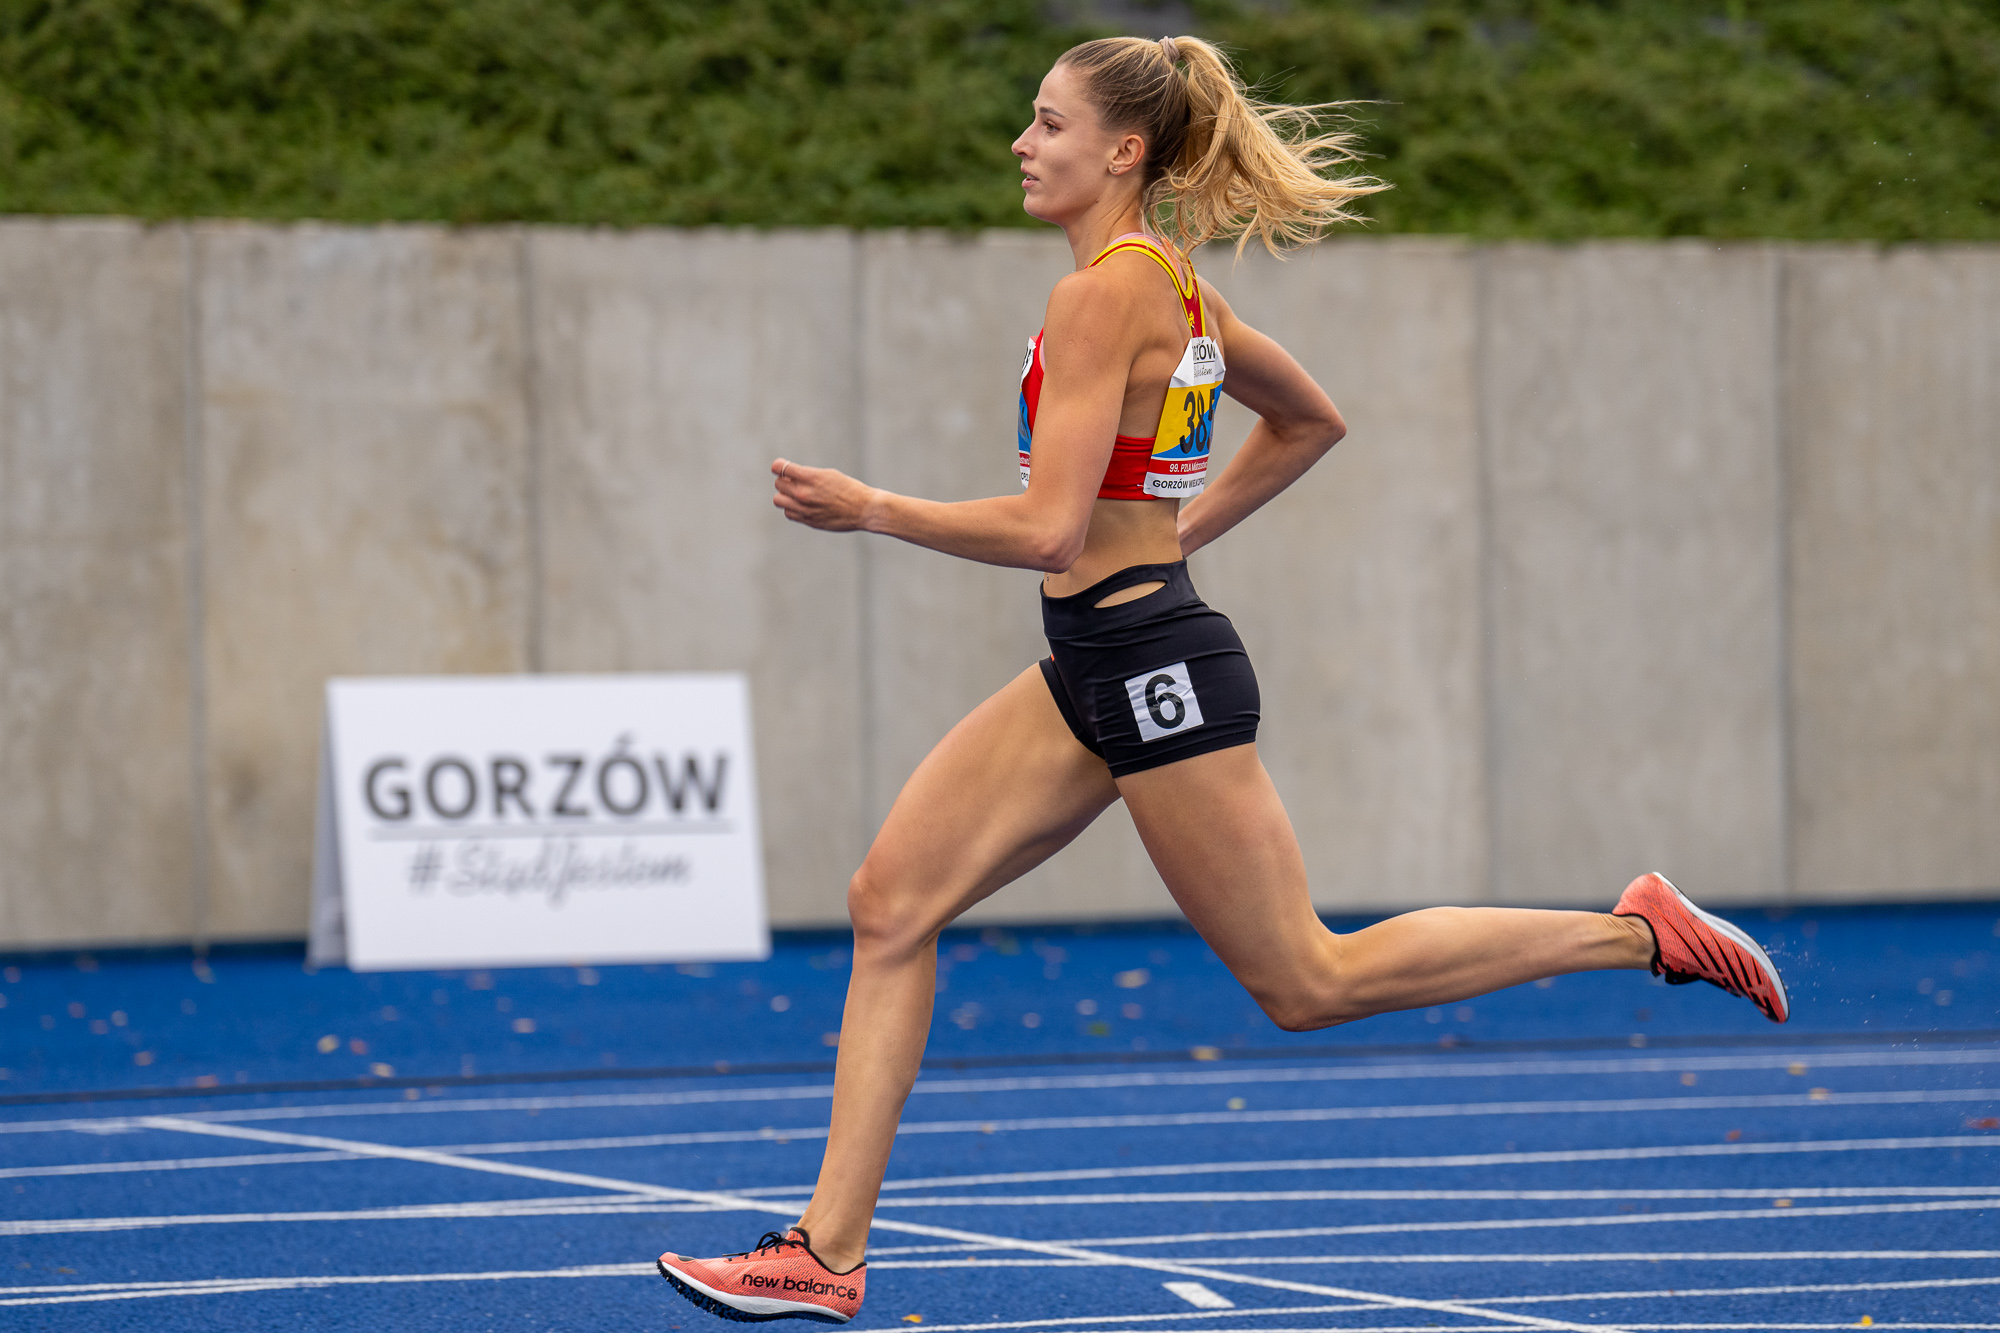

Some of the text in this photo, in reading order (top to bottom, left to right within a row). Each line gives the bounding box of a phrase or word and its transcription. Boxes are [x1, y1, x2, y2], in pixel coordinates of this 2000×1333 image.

[1169, 463, 1180, 473] 99.
[1152, 478, 1188, 489] GORZÓW
[1144, 673, 1186, 730] 6
[362, 732, 729, 822] GORZÓW
[741, 1273, 858, 1301] new balance
